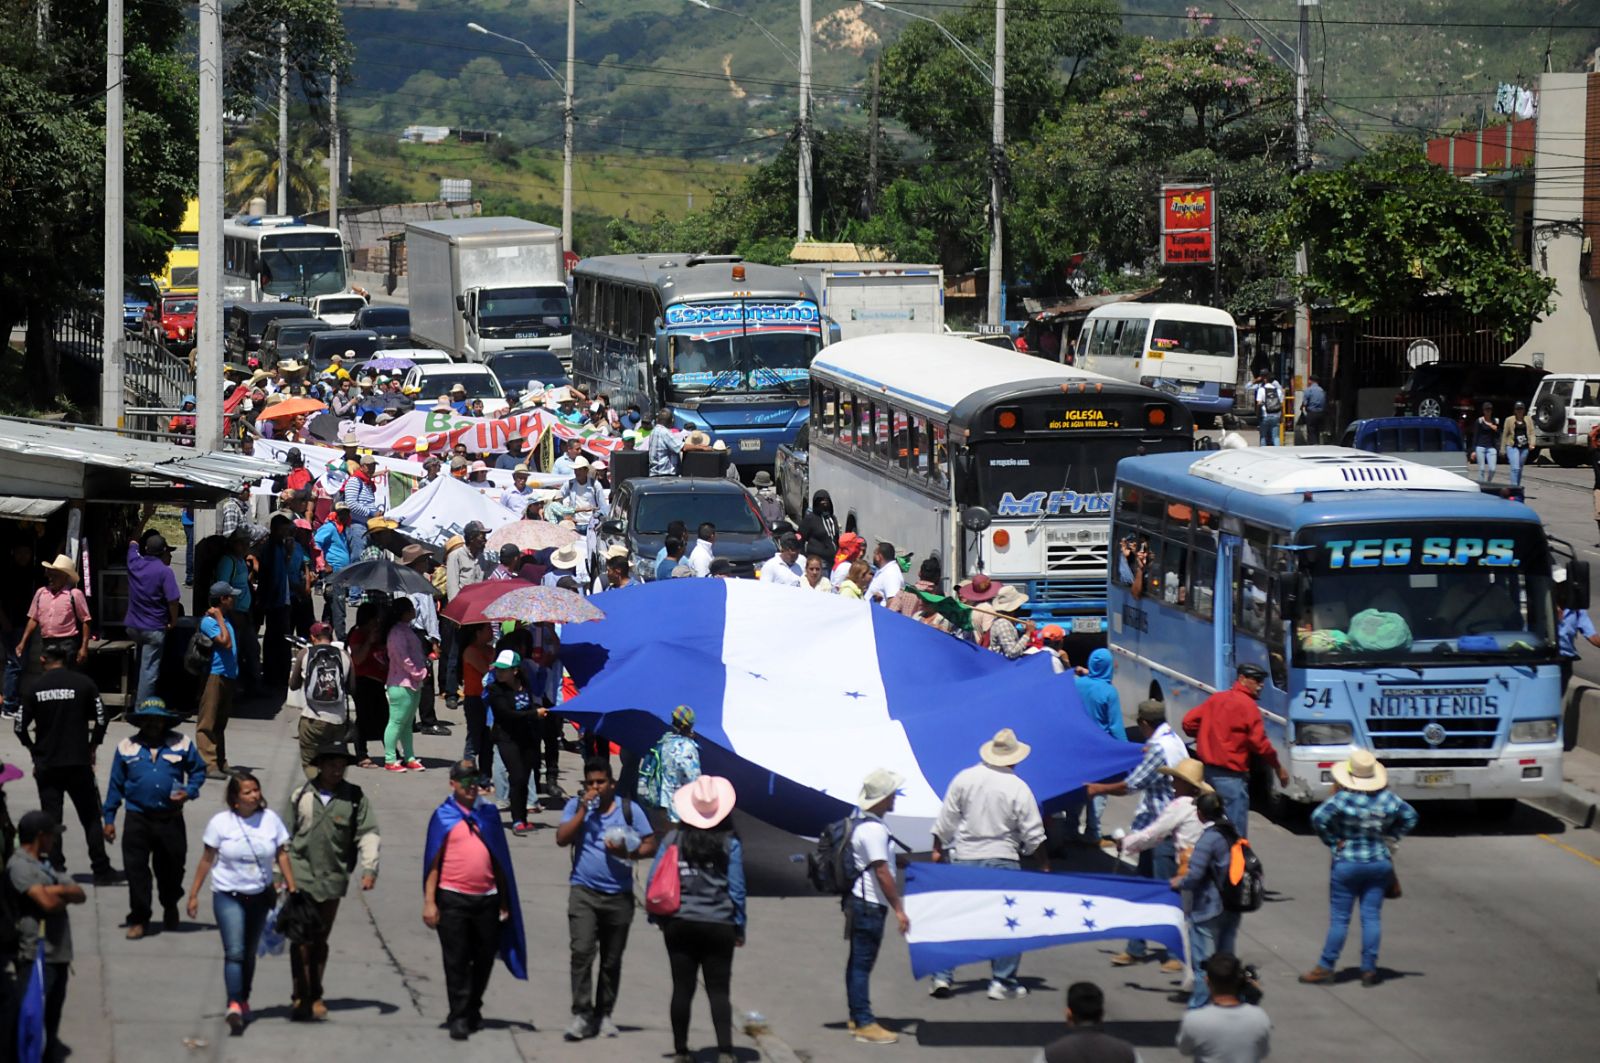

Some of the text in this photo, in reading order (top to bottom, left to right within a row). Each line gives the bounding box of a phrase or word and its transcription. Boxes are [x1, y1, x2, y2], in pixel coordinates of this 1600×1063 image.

[1171, 202, 1206, 214] Imperial
[1065, 410, 1104, 420] IGLESIA
[1047, 532, 1076, 541] BLUE
[1325, 537, 1521, 569] TEG S.P.S.
[35, 689, 76, 702] TEKNISEG
[1303, 687, 1333, 709] 54
[1383, 687, 1486, 697] ASHOK LEYLAND
